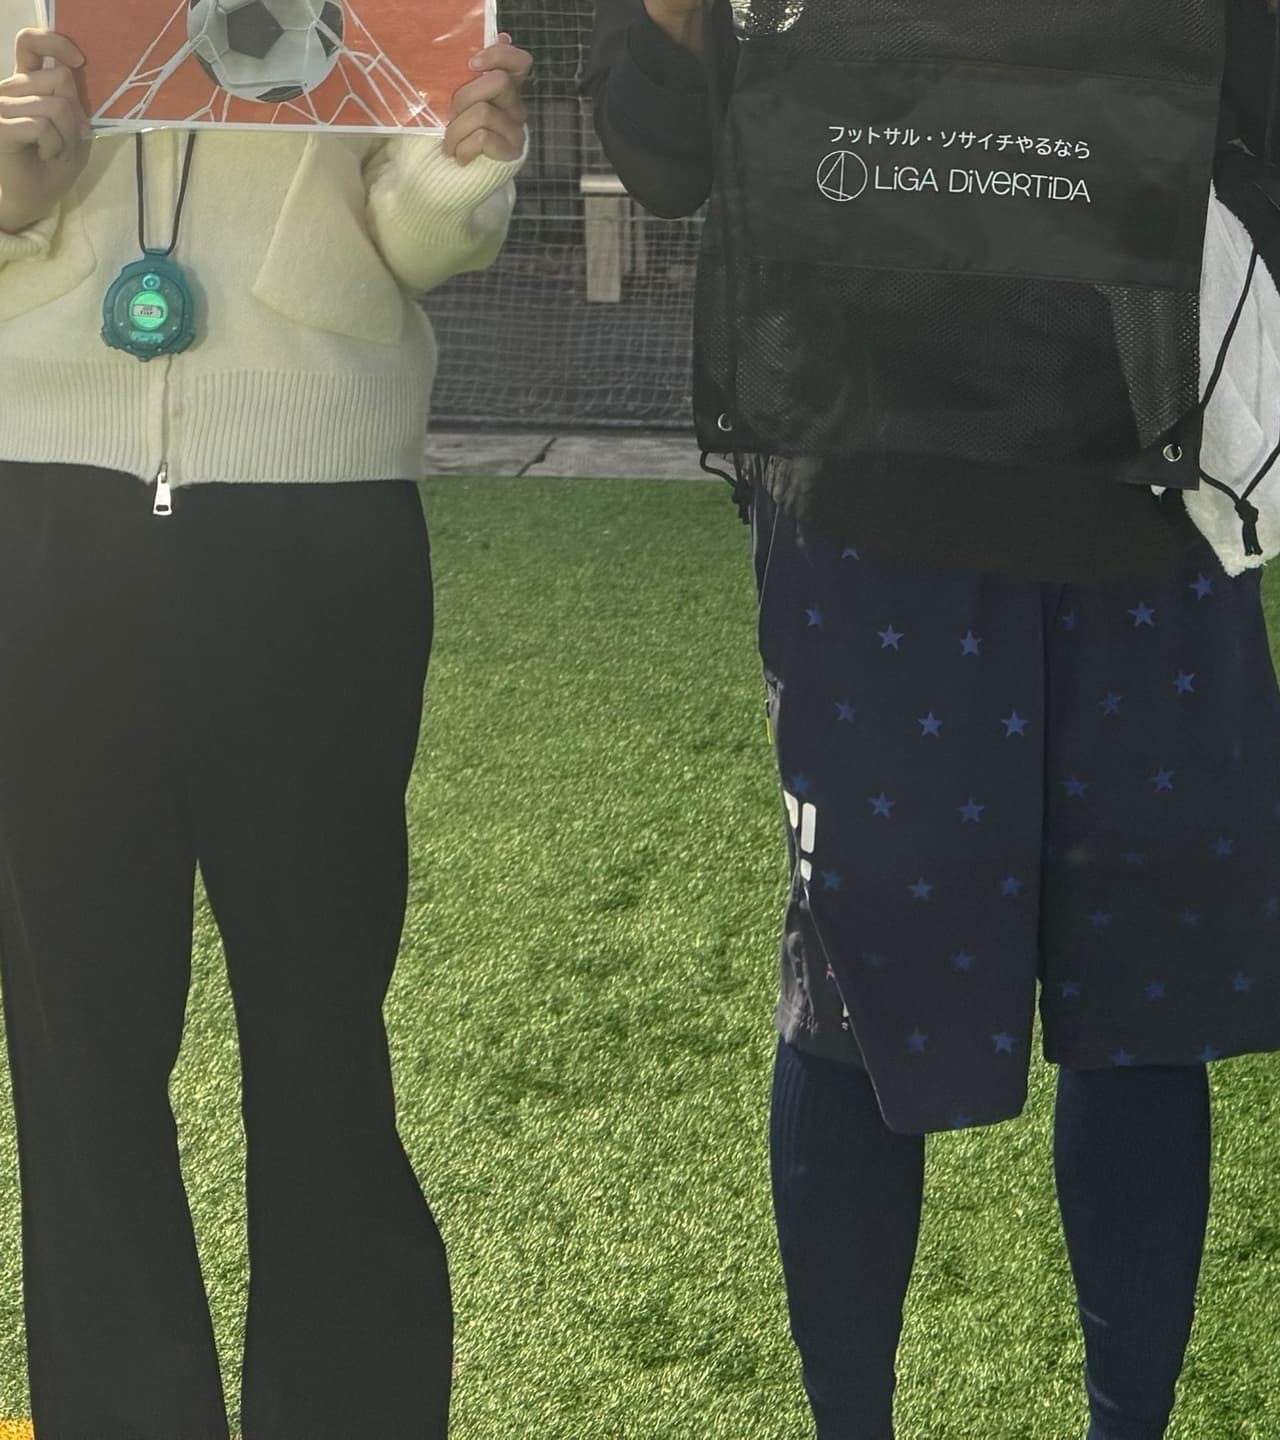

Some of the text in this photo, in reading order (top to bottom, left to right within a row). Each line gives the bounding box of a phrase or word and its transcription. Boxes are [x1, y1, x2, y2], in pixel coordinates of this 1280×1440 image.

[828, 125, 1091, 159] フットサル・ソサイチやるなら
